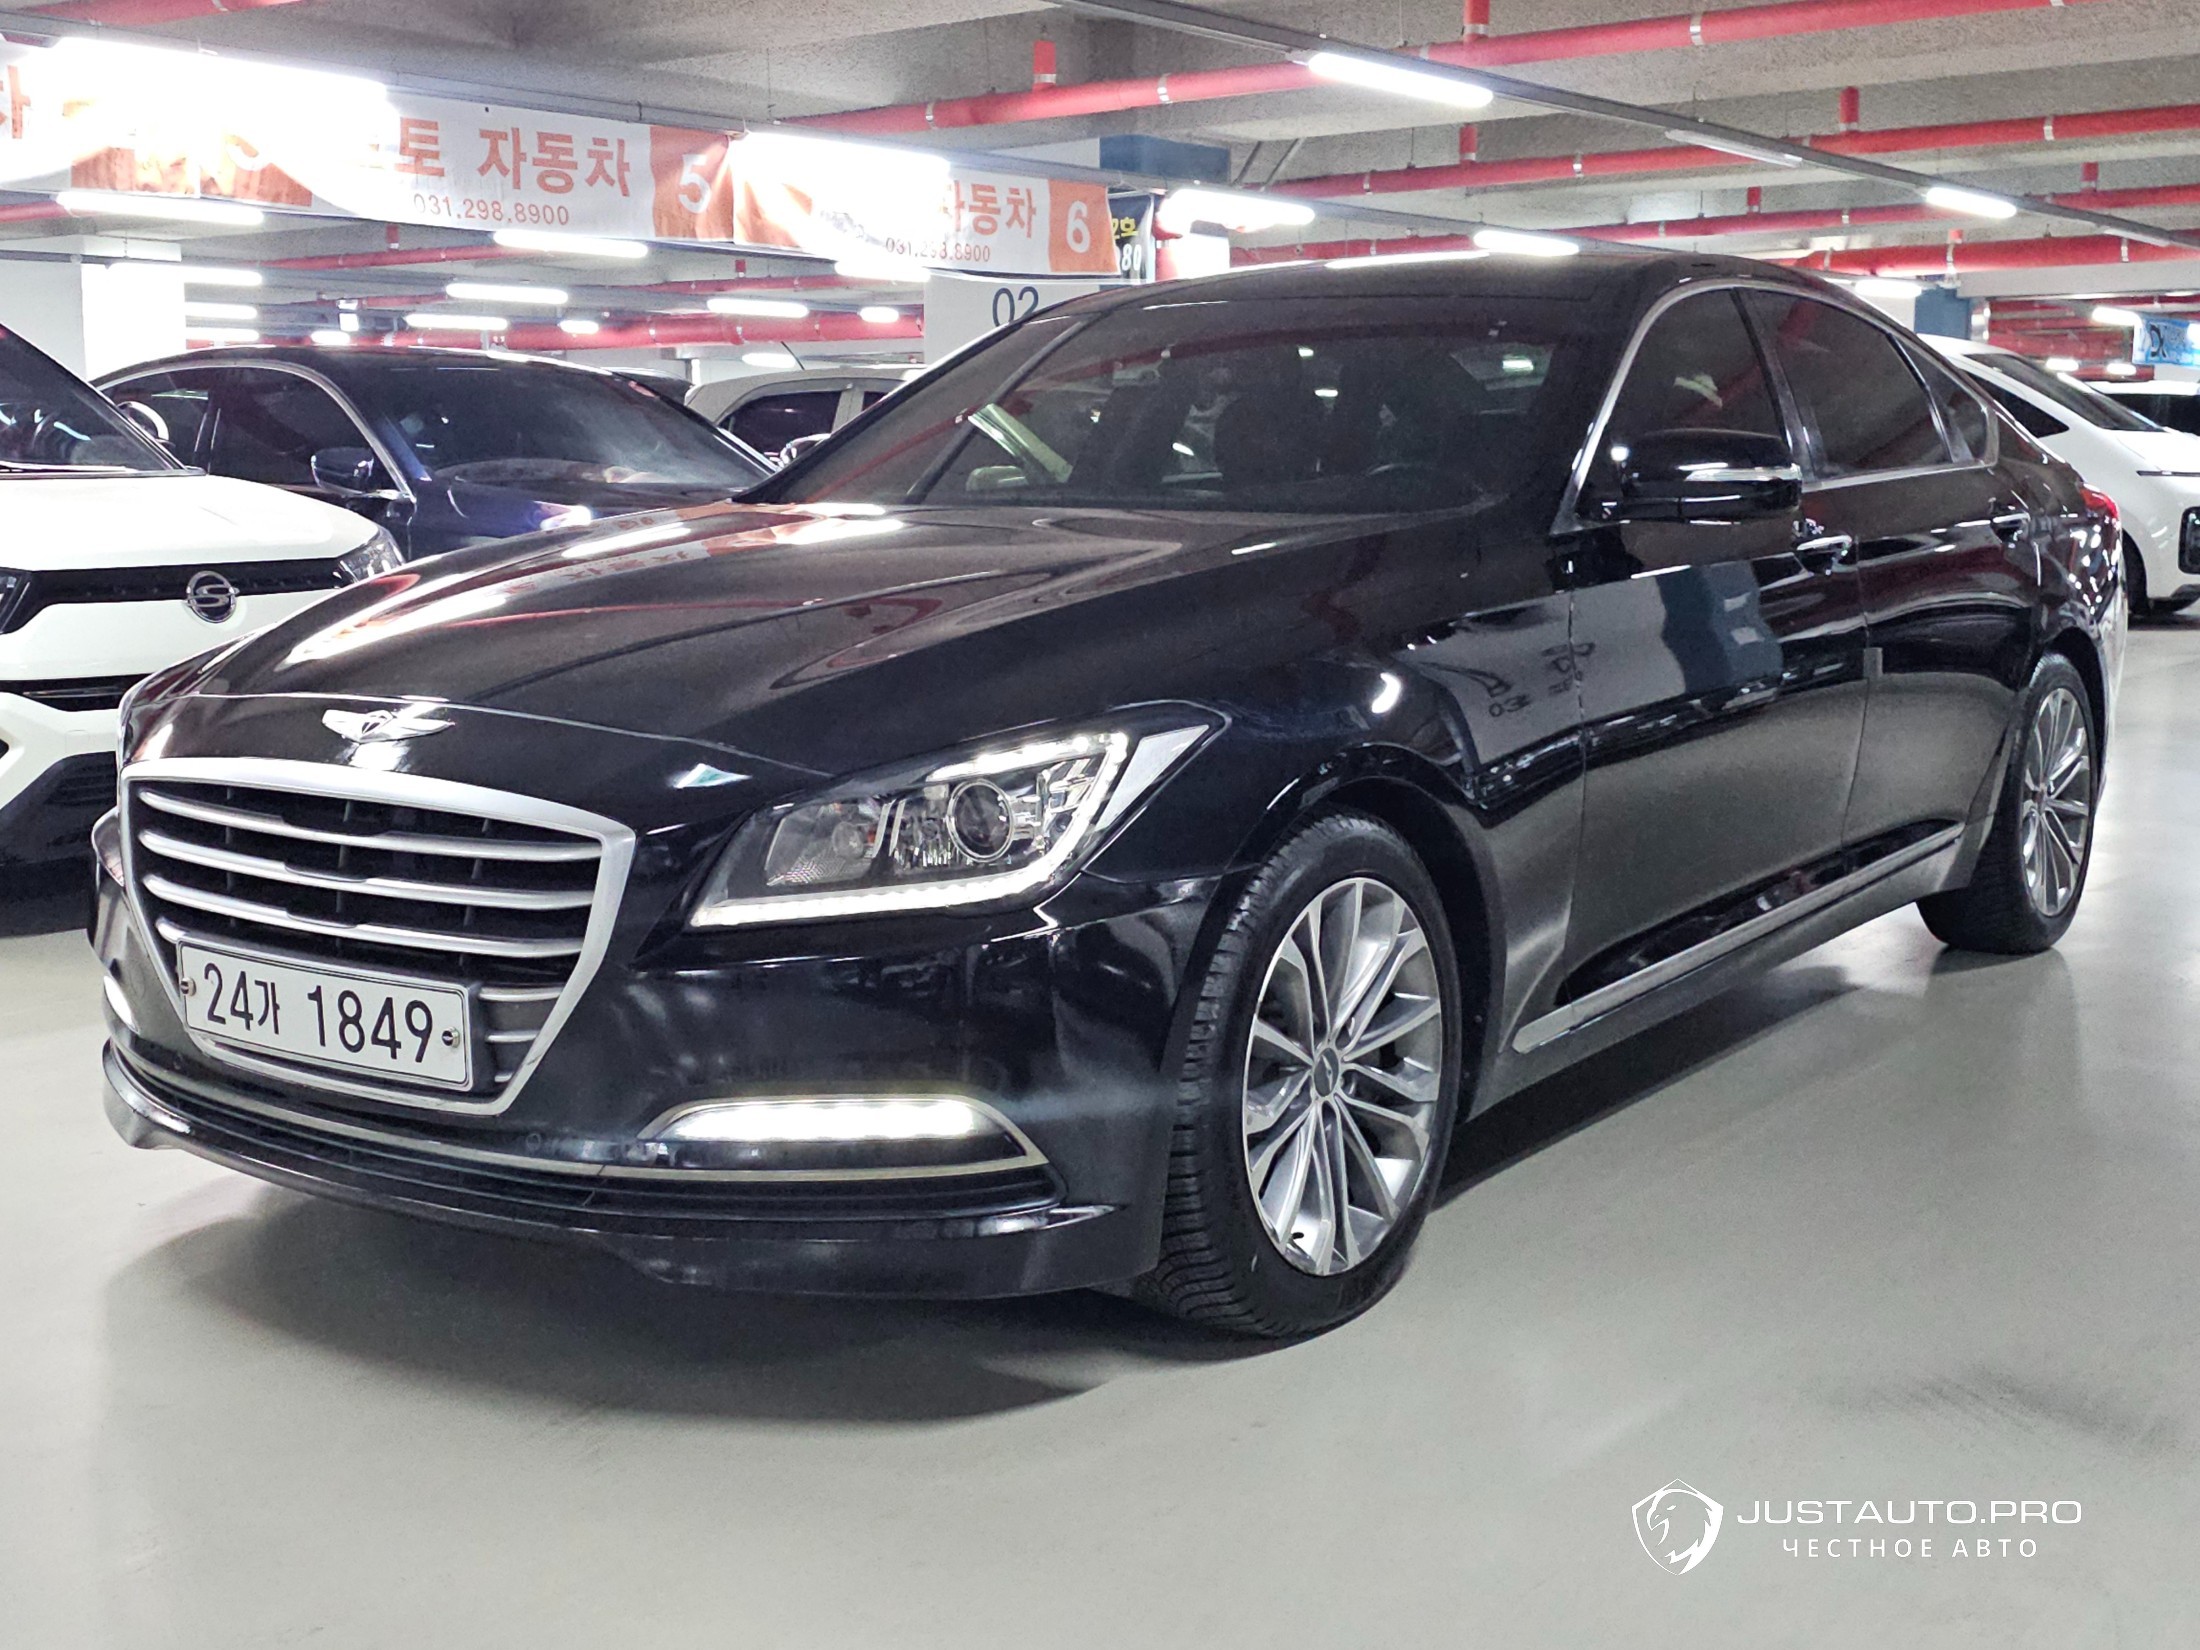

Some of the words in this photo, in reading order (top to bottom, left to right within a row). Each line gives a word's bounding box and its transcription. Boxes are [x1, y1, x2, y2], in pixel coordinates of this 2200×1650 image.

[477, 127, 630, 197] 자동차
[679, 154, 712, 213] 5
[413, 193, 569, 225] 031.298.8900
[1066, 200, 1091, 253] 6
[1117, 243, 1142, 271] 80
[993, 286, 1039, 327] 02
[203, 962, 281, 1035] 24가
[307, 985, 433, 1063] 1849
